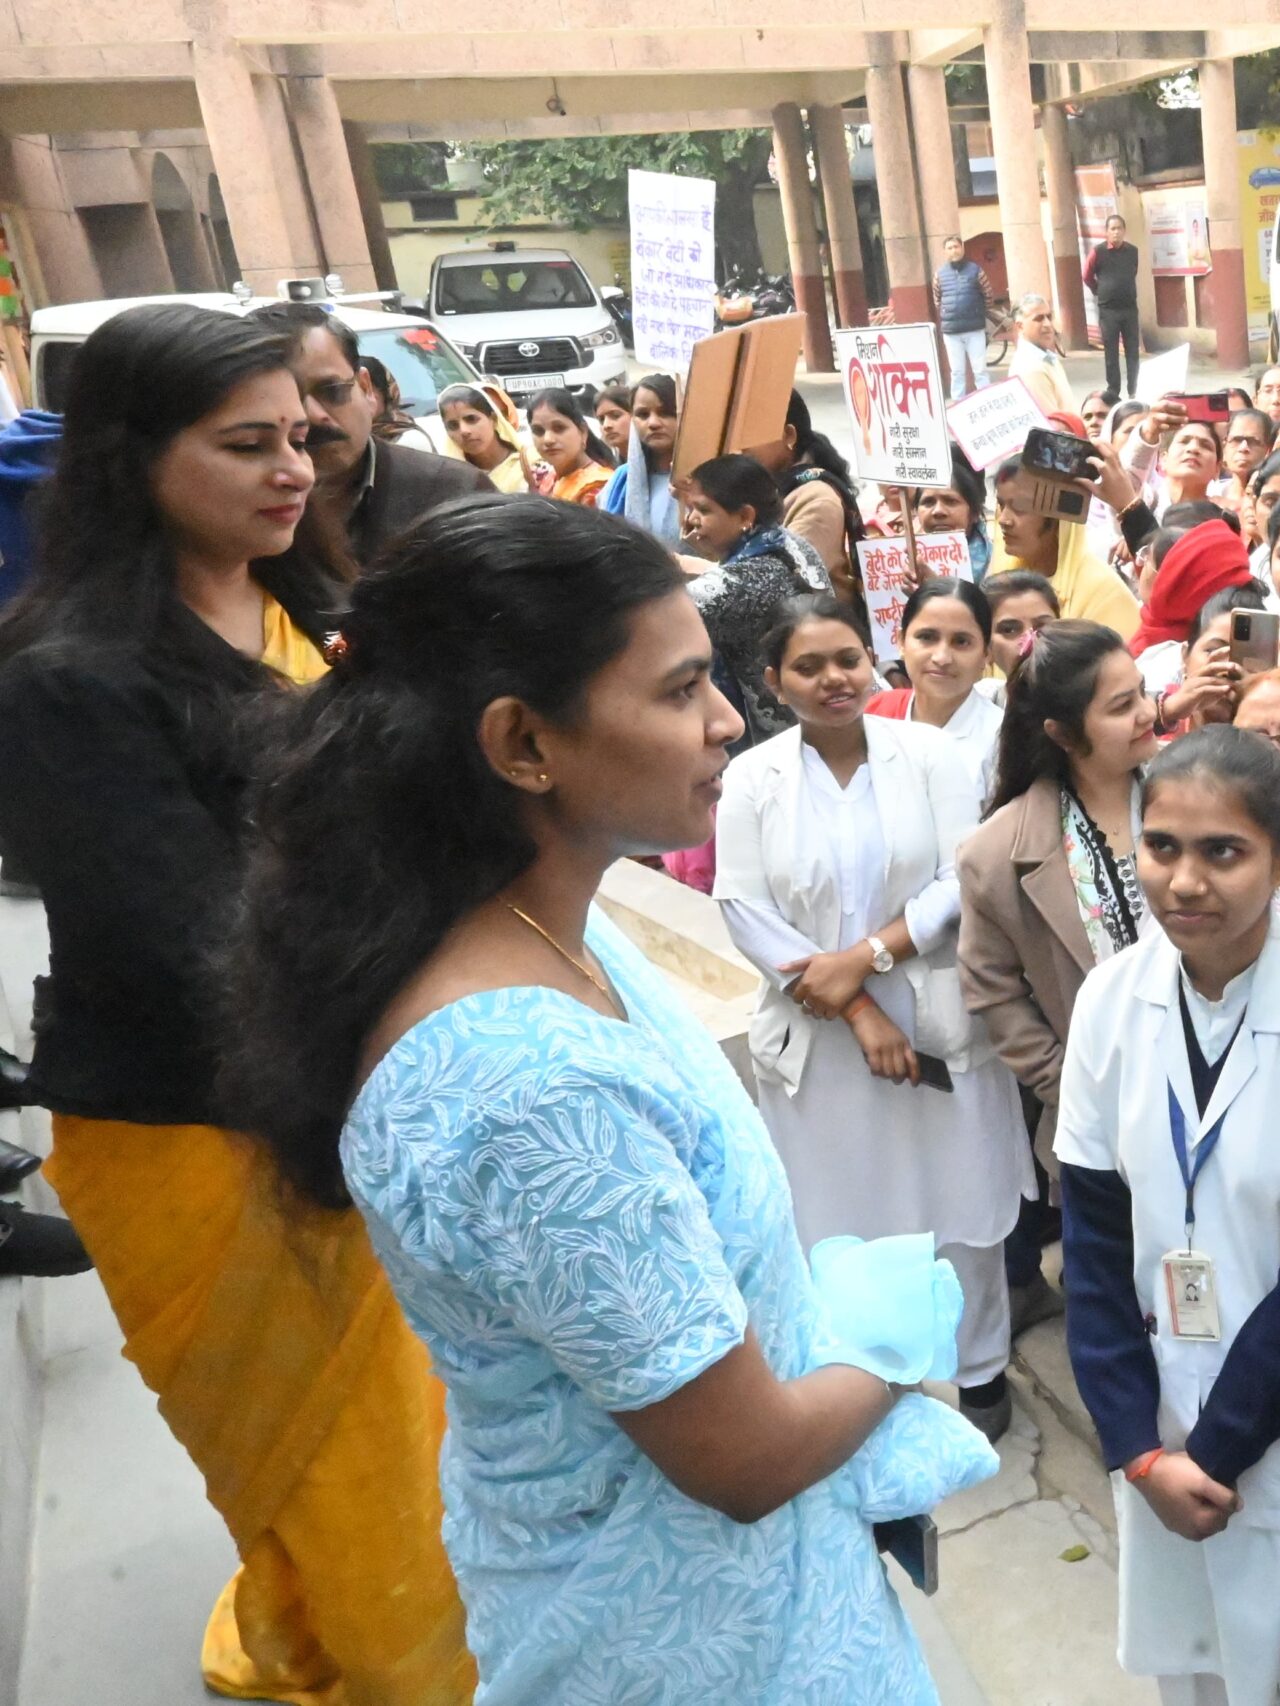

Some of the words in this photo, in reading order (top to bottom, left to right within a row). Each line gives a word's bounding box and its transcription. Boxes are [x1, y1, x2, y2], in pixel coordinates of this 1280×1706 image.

[855, 335, 880, 361] मिशन
[867, 334, 935, 454] शक्ति
[889, 422, 901, 439] नारी
[902, 426, 920, 445] सुरक्षा
[892, 446, 904, 459] नारी
[905, 447, 927, 460] सम्मान
[895, 464, 907, 479] नारी
[887, 546, 902, 569] को
[905, 541, 949, 563] धिकार
[873, 595, 906, 629] राष्ट्री
